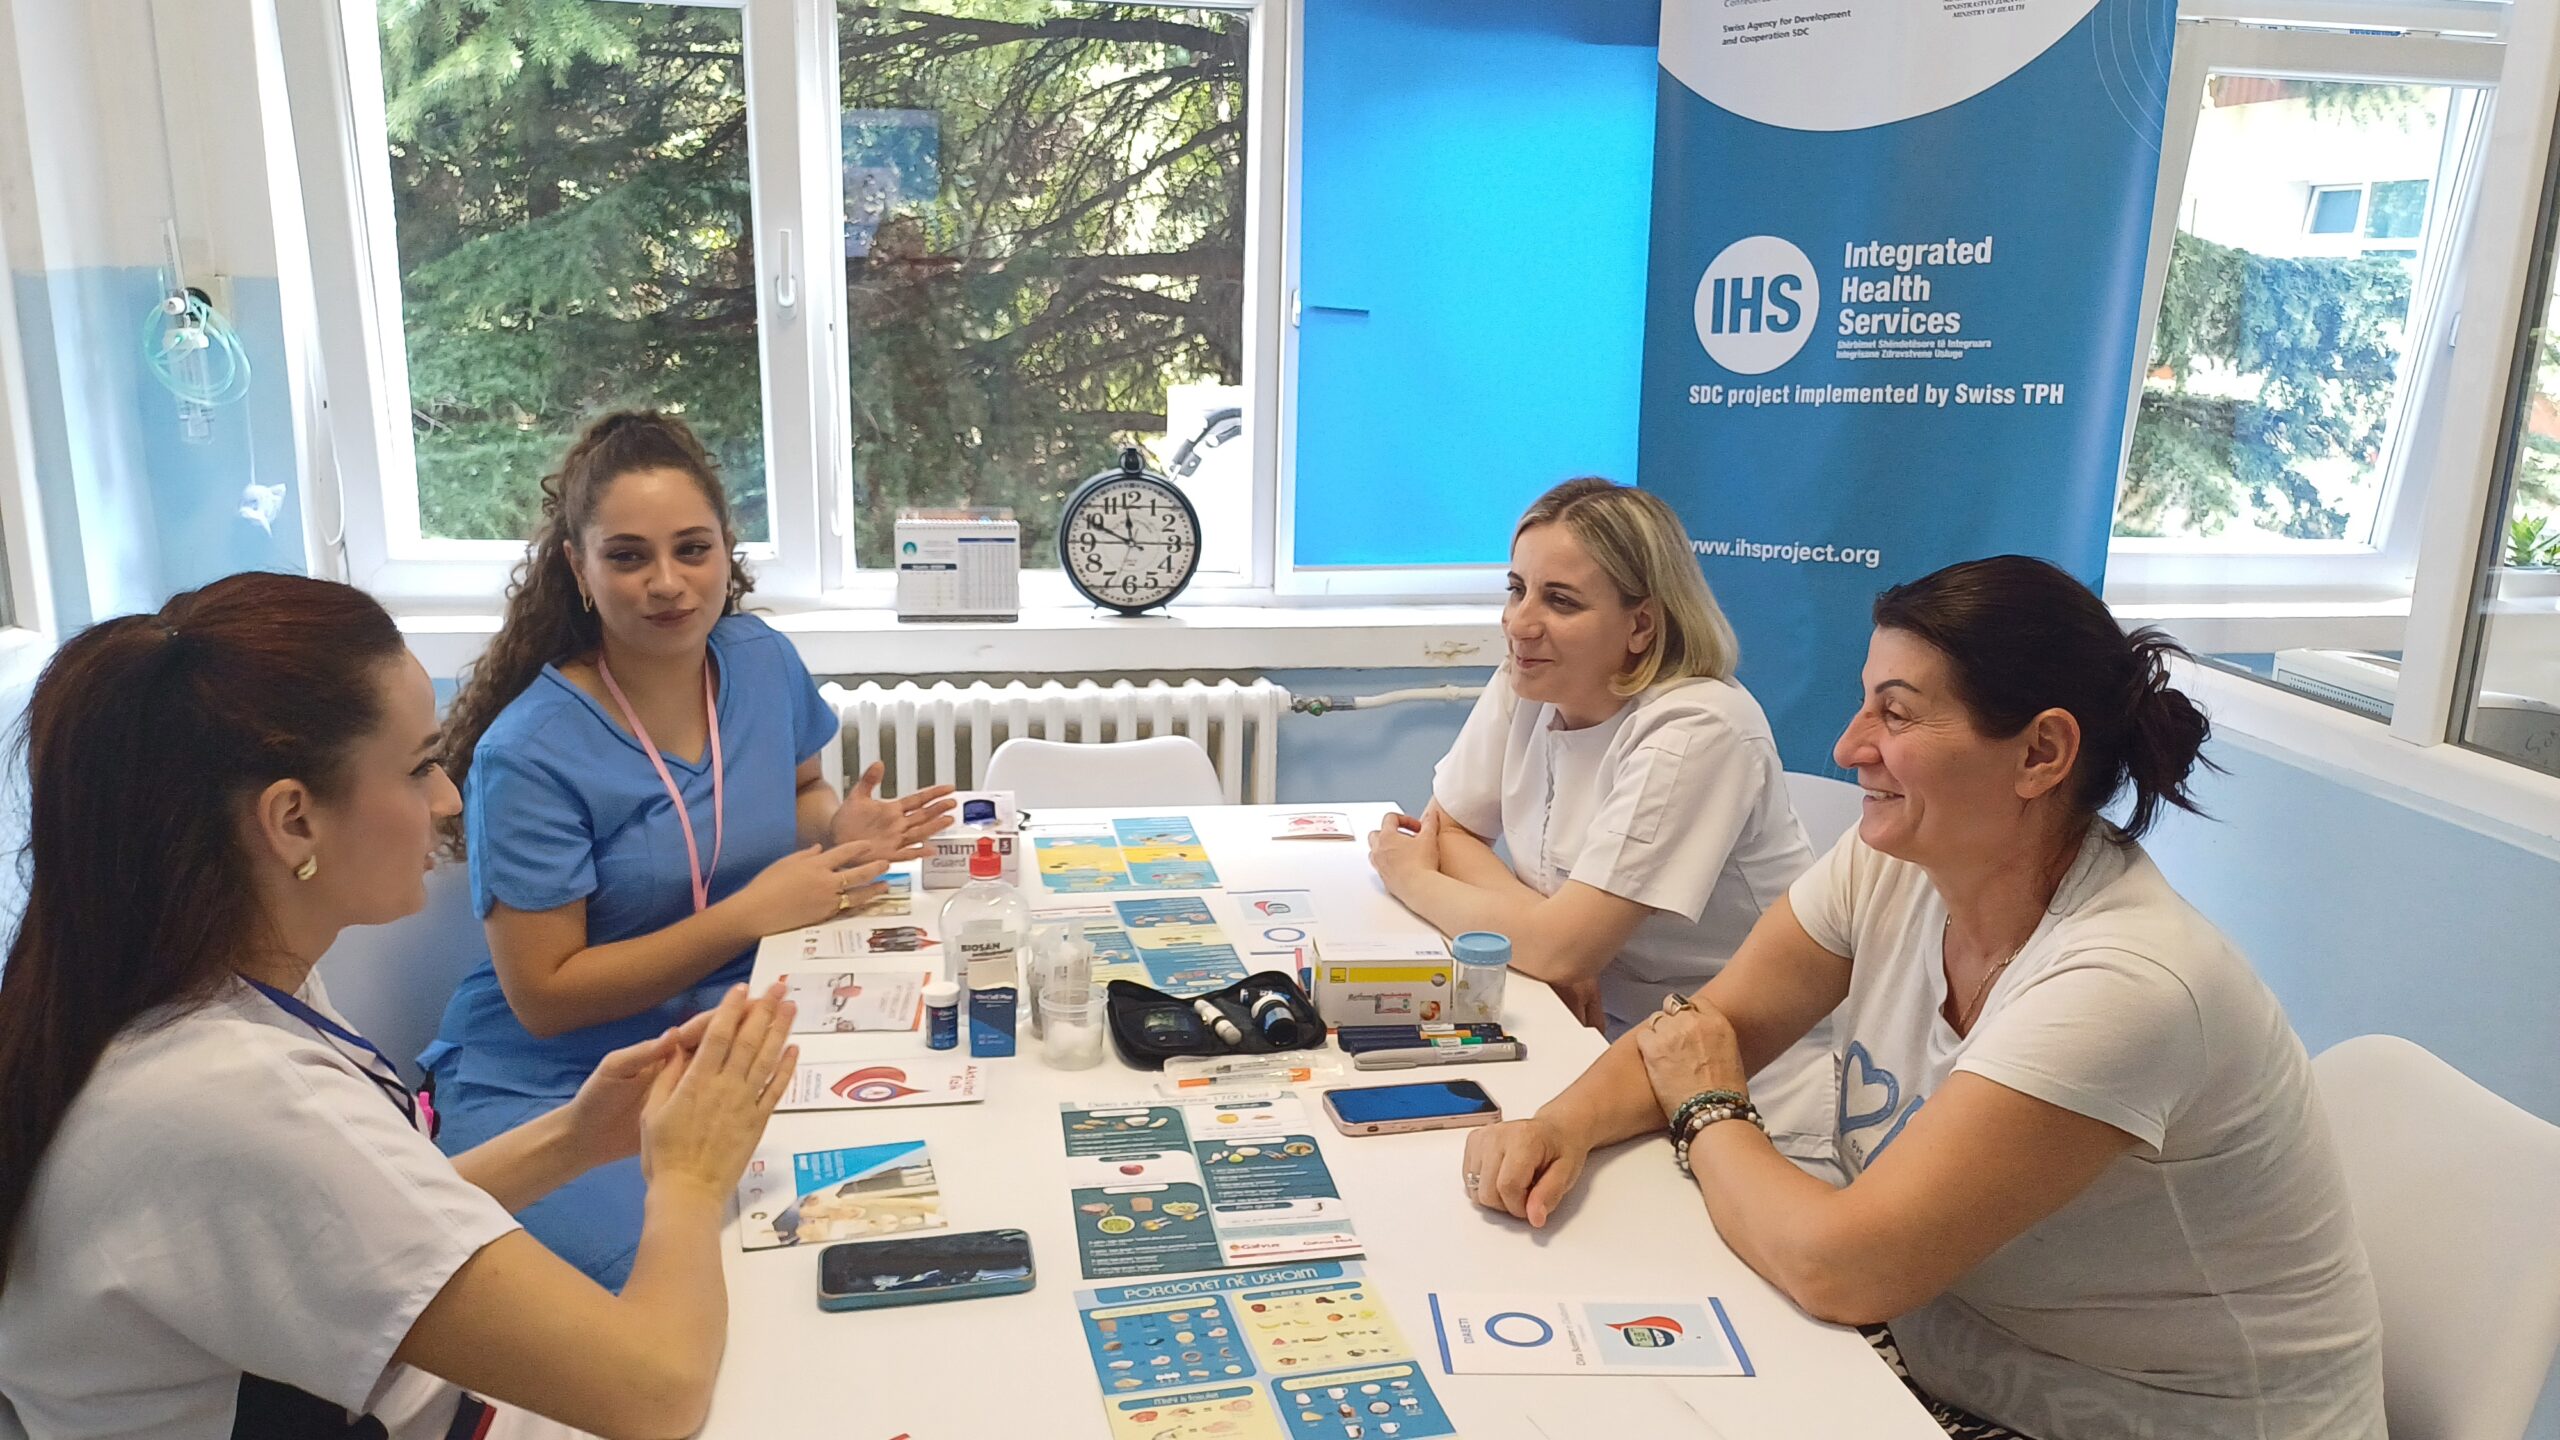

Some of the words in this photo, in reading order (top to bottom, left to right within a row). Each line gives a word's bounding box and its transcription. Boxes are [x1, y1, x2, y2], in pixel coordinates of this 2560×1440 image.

[1723, 24, 1745, 32] Swiss
[1747, 19, 1777, 31] Agency
[1795, 10, 1851, 24] Development
[1722, 36, 1737, 45] and
[1740, 31, 1790, 43] Cooperation
[1792, 28, 1809, 37] SDC
[1844, 235, 1993, 272] Integrated
[1841, 275, 1931, 304] Health
[1710, 274, 1802, 334] IHS
[1838, 308, 1961, 336] Services
[1689, 384, 1724, 404] SDC
[1727, 384, 1789, 408] project
[1795, 384, 1918, 408] implemented
[1925, 383, 1949, 408] by
[1955, 383, 2016, 405] Swiss
[2022, 383, 2064, 405] TPH
[1104, 497, 1117, 515] 11
[1122, 490, 1141, 509] 12
[1150, 499, 1156, 517] 1
[1086, 513, 1103, 530] 10
[1162, 514, 1176, 532] 2
[1080, 532, 1096, 553] 9
[1167, 535, 1182, 553] 3
[1085, 553, 1103, 573] 8
[1157, 555, 1174, 574] 4
[1103, 571, 1117, 588] 7
[1122, 575, 1138, 595] 6
[1144, 572, 1158, 589] 5
[932, 858, 965, 867] Guard
[1123, 1279, 1221, 1301] PORCIONET
